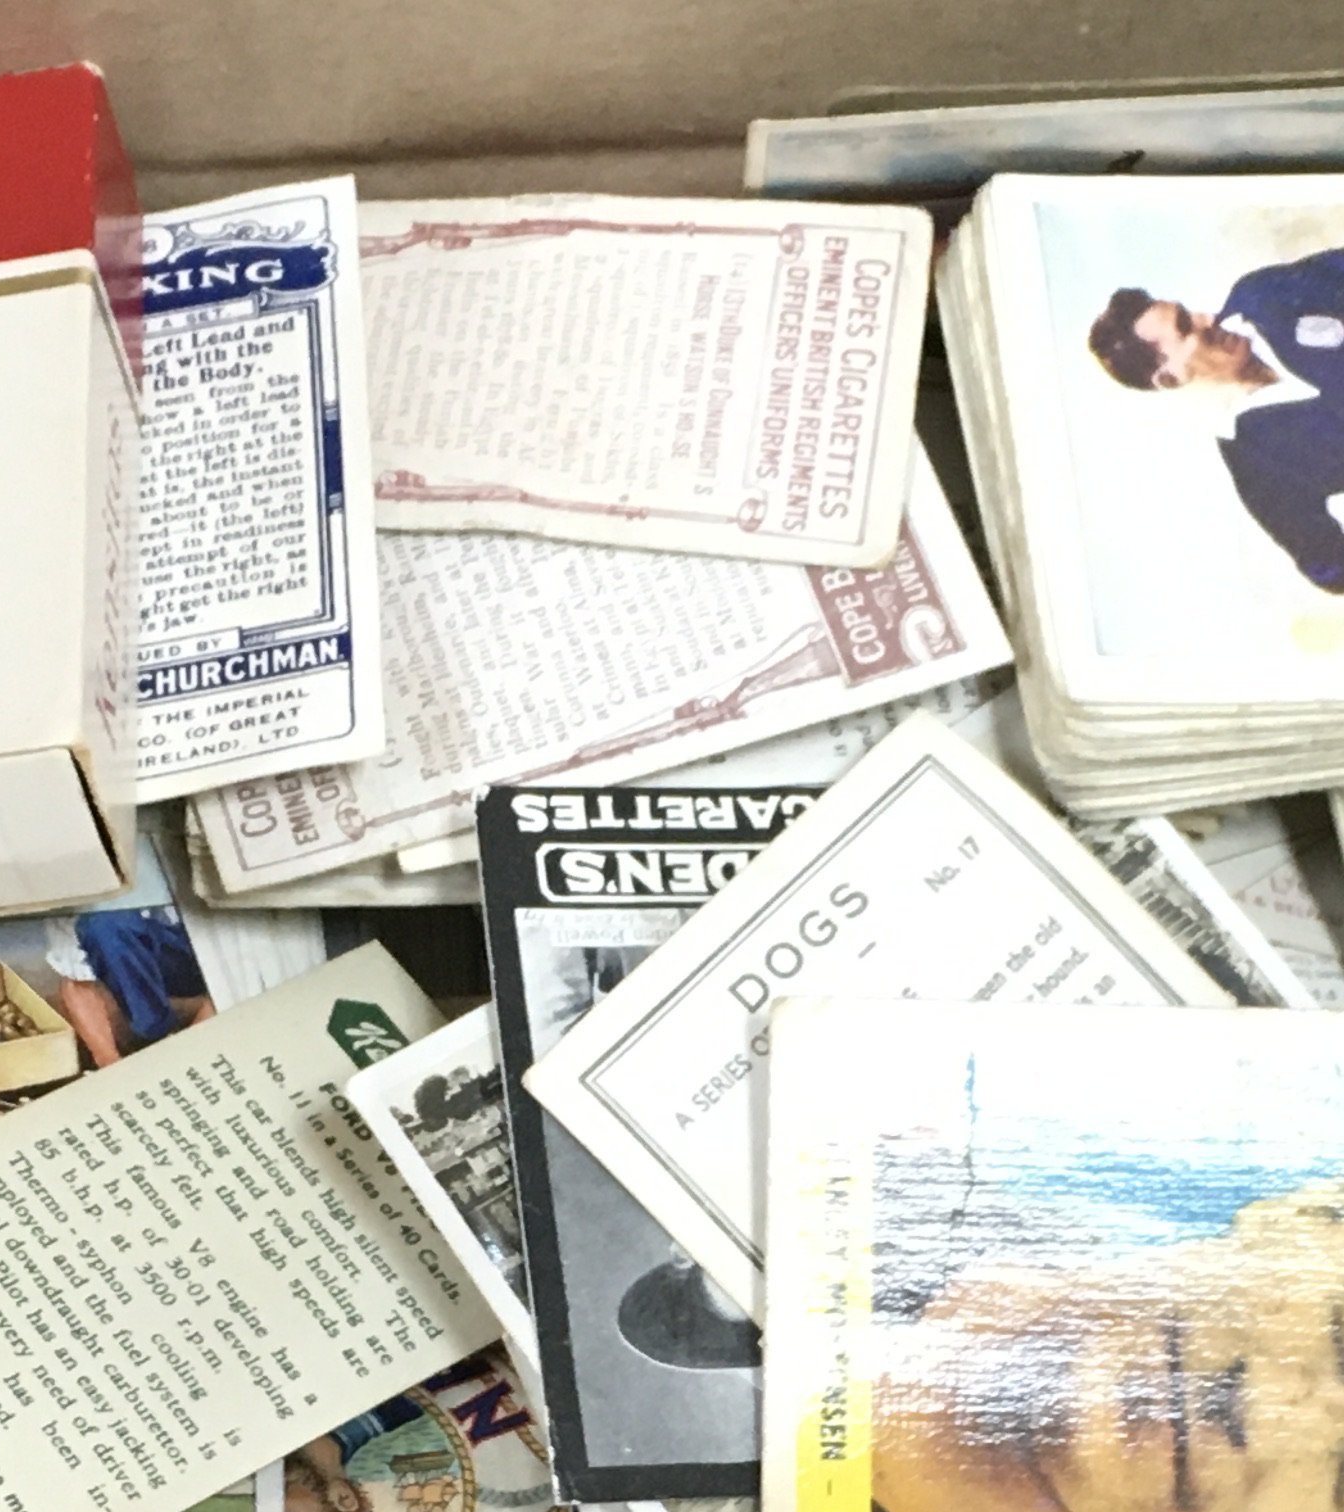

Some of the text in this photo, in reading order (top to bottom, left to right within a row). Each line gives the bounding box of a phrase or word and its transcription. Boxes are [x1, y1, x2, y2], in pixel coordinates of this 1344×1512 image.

[178, 341, 272, 367] with the
[190, 325, 244, 348] Lead
[252, 316, 294, 336] and
[153, 361, 262, 390] the Body.
[782, 236, 848, 531] EMINENT BRITISH REGIMENTS
[818, 258, 890, 519] COPE'S CIGARETTES
[756, 367, 793, 479] UNIFORMS
[829, 589, 889, 666] COPE
[153, 688, 311, 727] THE IMPERIAL
[184, 724, 220, 743] (OF
[229, 705, 303, 731] GREAT
[258, 726, 299, 744] LTD
[923, 835, 982, 893] No. 17
[727, 879, 870, 1015] DOGS
[1003, 942, 1035, 973] the
[1032, 915, 1062, 947] old
[1032, 944, 1090, 998] hound.
[319, 1080, 373, 1143] FORD
[673, 1108, 696, 1132] A
[692, 1053, 754, 1116] SERIES
[185, 1064, 419, 1353] with luxurious comfort. The
[210, 1053, 248, 1096] This
[244, 1098, 272, 1126] car
[269, 1126, 322, 1187] blends
[317, 1187, 357, 1232] high
[353, 1232, 399, 1283] silent
[394, 1285, 445, 1341] speed
[258, 1054, 289, 1089] No.
[287, 1089, 311, 1111] 11
[306, 1112, 327, 1133] in
[323, 1135, 336, 1147] a
[335, 1147, 381, 1200] Series
[378, 1200, 402, 1222] of
[397, 1223, 421, 1247] 40
[415, 1247, 464, 1306] Cards.
